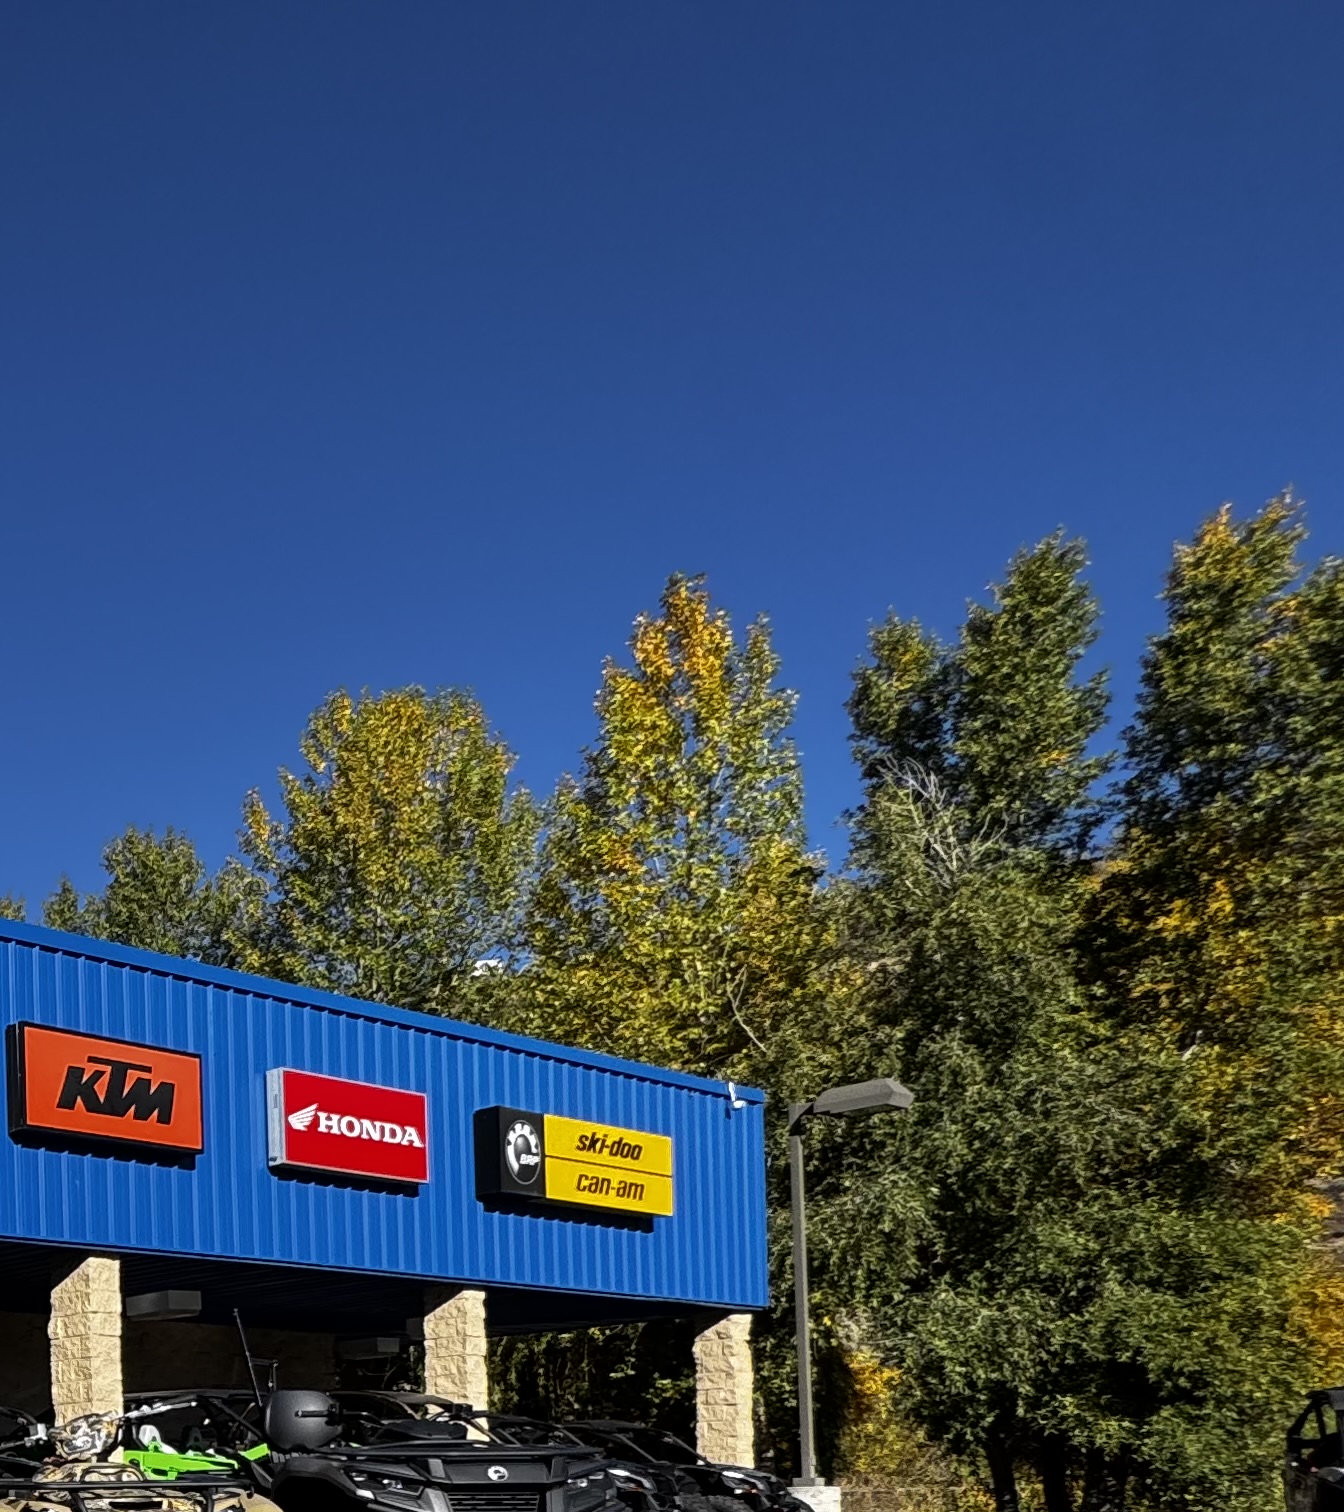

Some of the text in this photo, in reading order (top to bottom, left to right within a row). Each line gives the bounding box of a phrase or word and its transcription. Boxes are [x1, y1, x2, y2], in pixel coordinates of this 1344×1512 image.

[56, 1056, 175, 1125] KTM
[317, 1111, 424, 1147] HONDA
[576, 1132, 643, 1161] ski-doo
[576, 1174, 645, 1200] can-am
